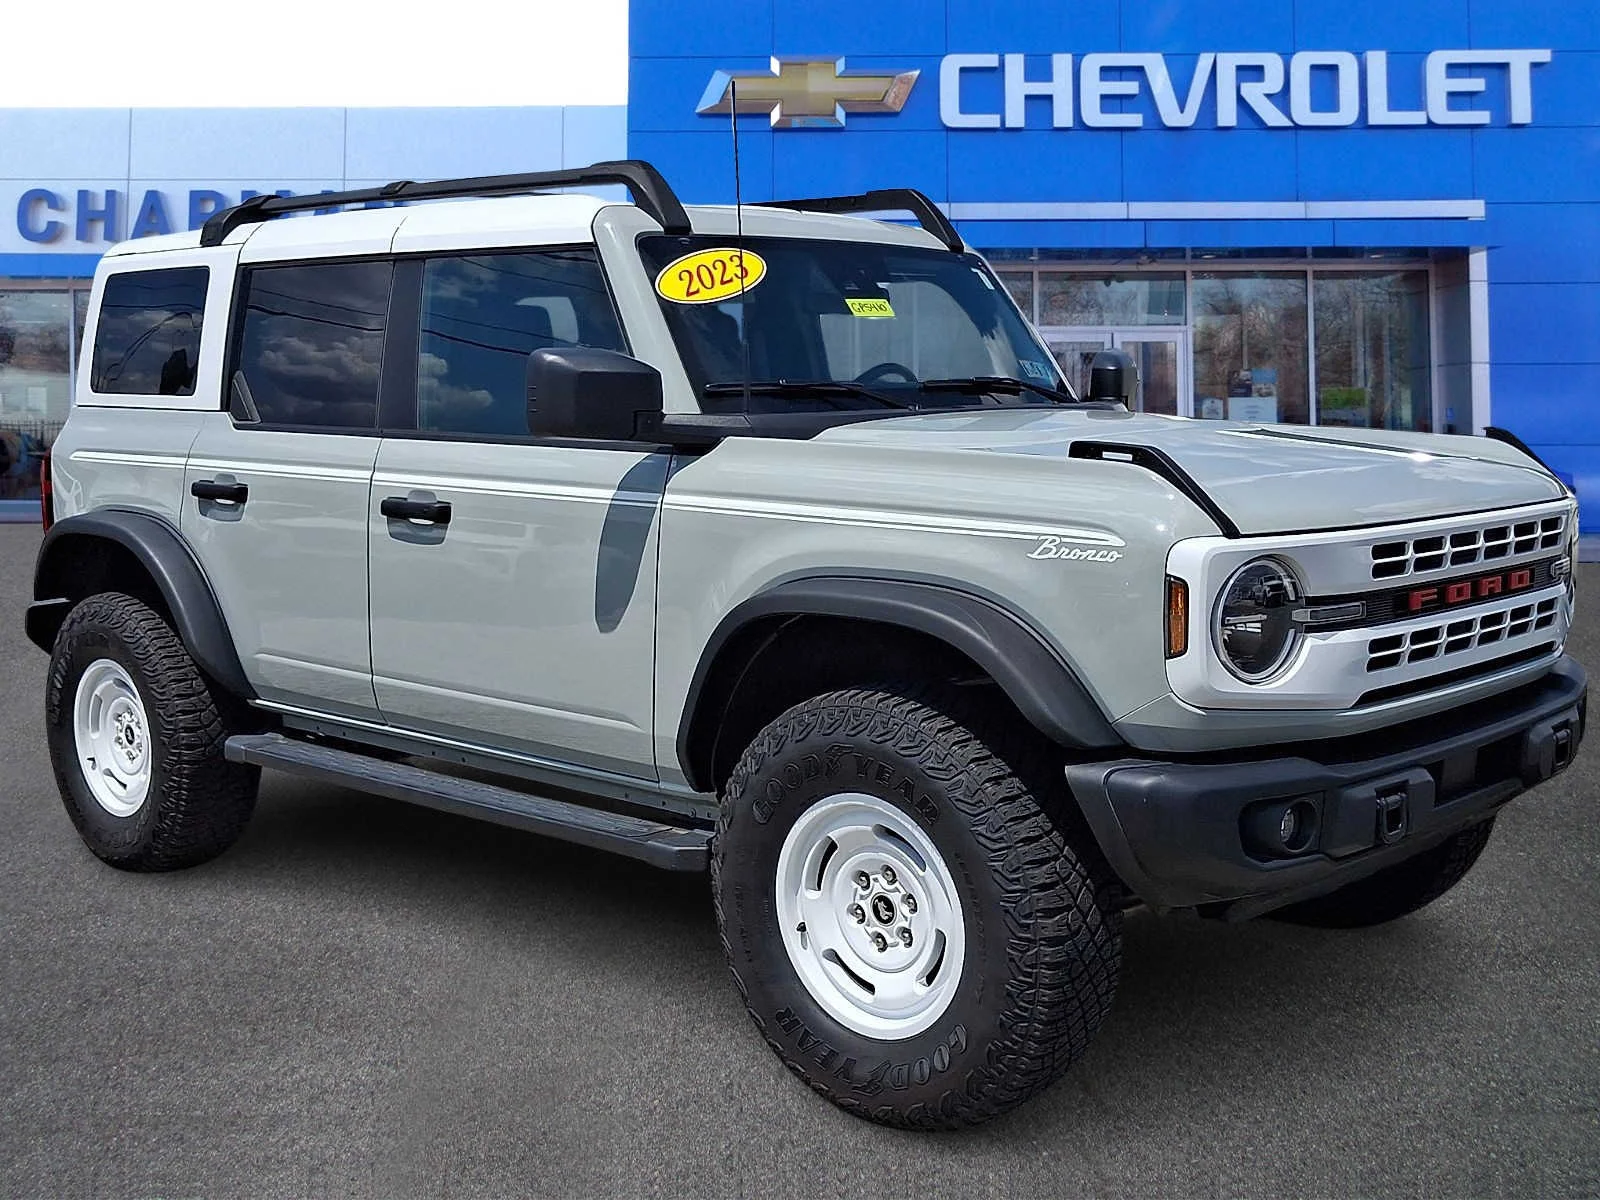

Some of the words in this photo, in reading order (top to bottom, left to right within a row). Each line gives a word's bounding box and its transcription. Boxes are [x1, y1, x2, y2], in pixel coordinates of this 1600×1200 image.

[939, 49, 1552, 128] CHEVROLET
[679, 254, 749, 297] 2023
[1026, 535, 1123, 562] Bronco
[1408, 570, 1530, 611] FORD
